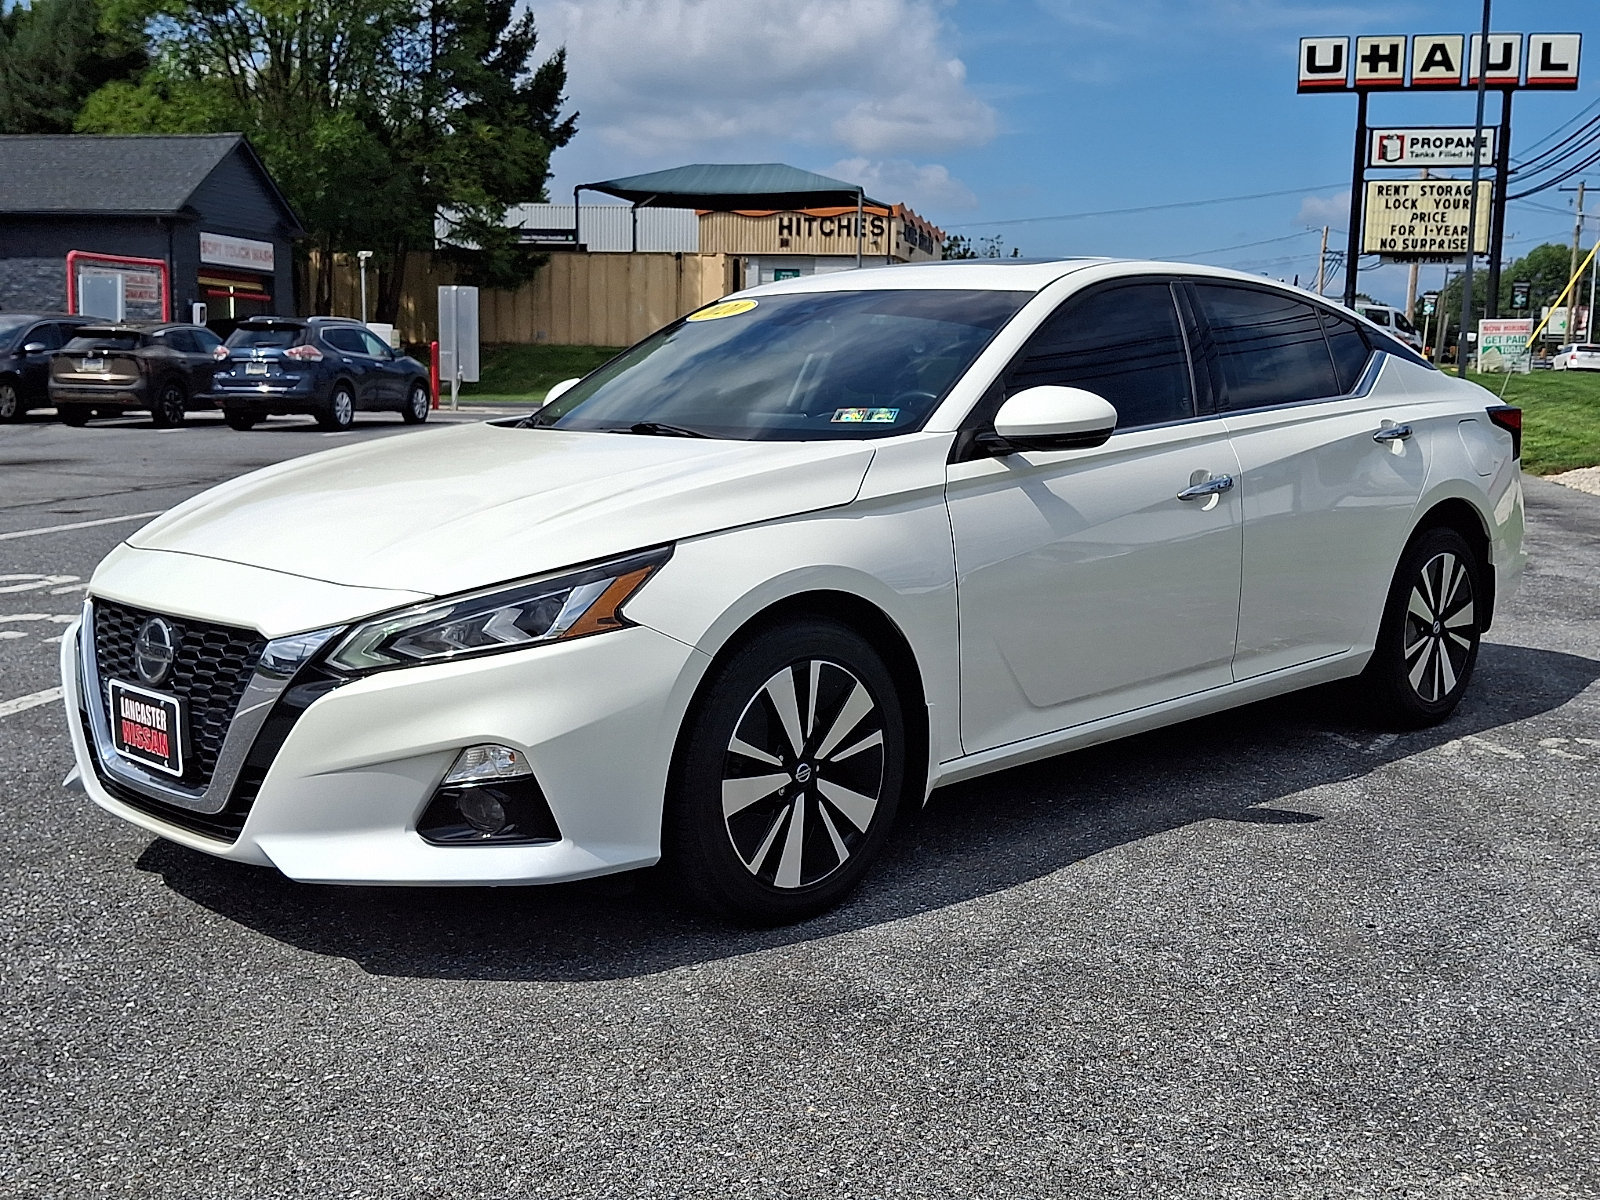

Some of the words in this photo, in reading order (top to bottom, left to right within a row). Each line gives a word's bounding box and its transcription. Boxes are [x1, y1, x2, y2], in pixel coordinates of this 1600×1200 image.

[1410, 137, 1488, 149] PROPANE
[1377, 185, 1409, 196] RENT
[1420, 185, 1472, 197] STORAG
[1385, 199, 1418, 209] LOCK
[1434, 198, 1470, 210] YOUR
[1410, 212, 1447, 223] PRICE
[778, 216, 885, 238] HITCHES
[1390, 225, 1415, 236] FOR
[1380, 239, 1397, 249] NO
[1485, 335, 1502, 344] GET
[1506, 335, 1528, 344] PAID
[120, 696, 167, 731] LANCASTER
[122, 719, 169, 758] NISSAN
